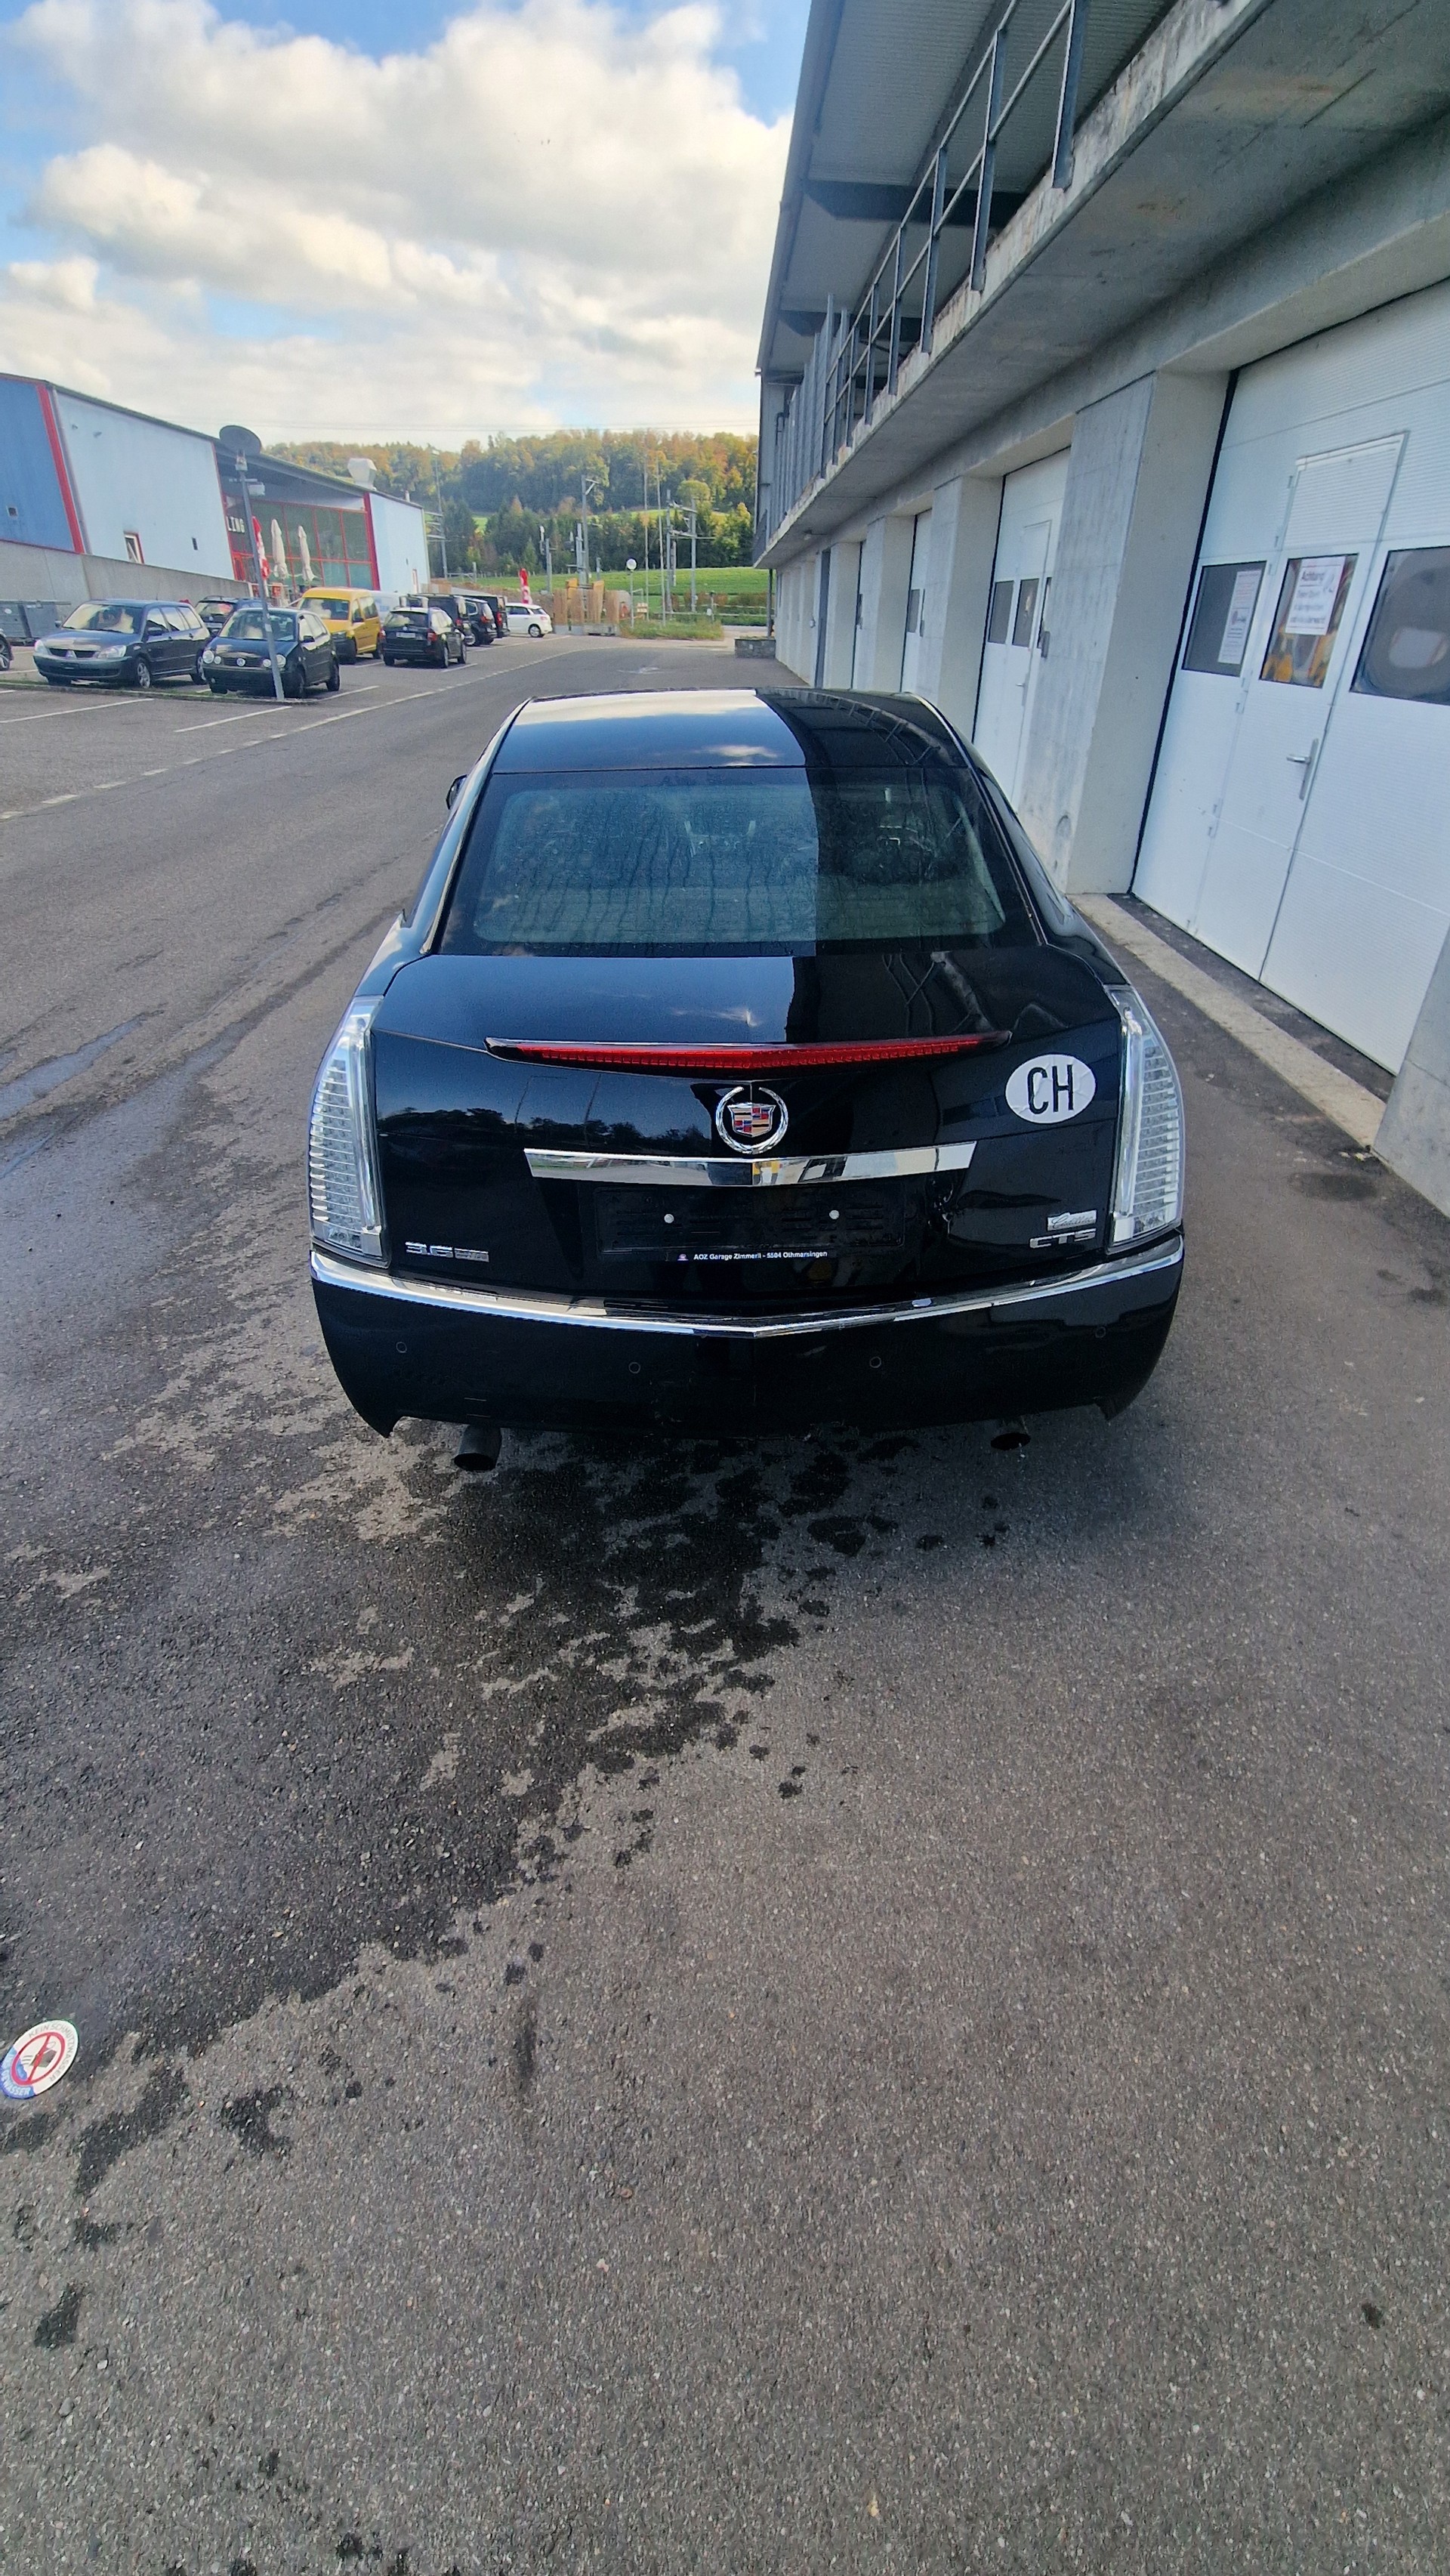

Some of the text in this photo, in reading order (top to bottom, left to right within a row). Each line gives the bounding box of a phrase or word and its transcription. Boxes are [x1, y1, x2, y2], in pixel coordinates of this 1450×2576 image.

[1027, 1064, 1074, 1114] CH
[1050, 1213, 1094, 1229] Cadillac
[1029, 1228, 1097, 1249] CTS
[709, 1253, 733, 1262] Garage
[782, 1250, 828, 1260] Othmarsingen
